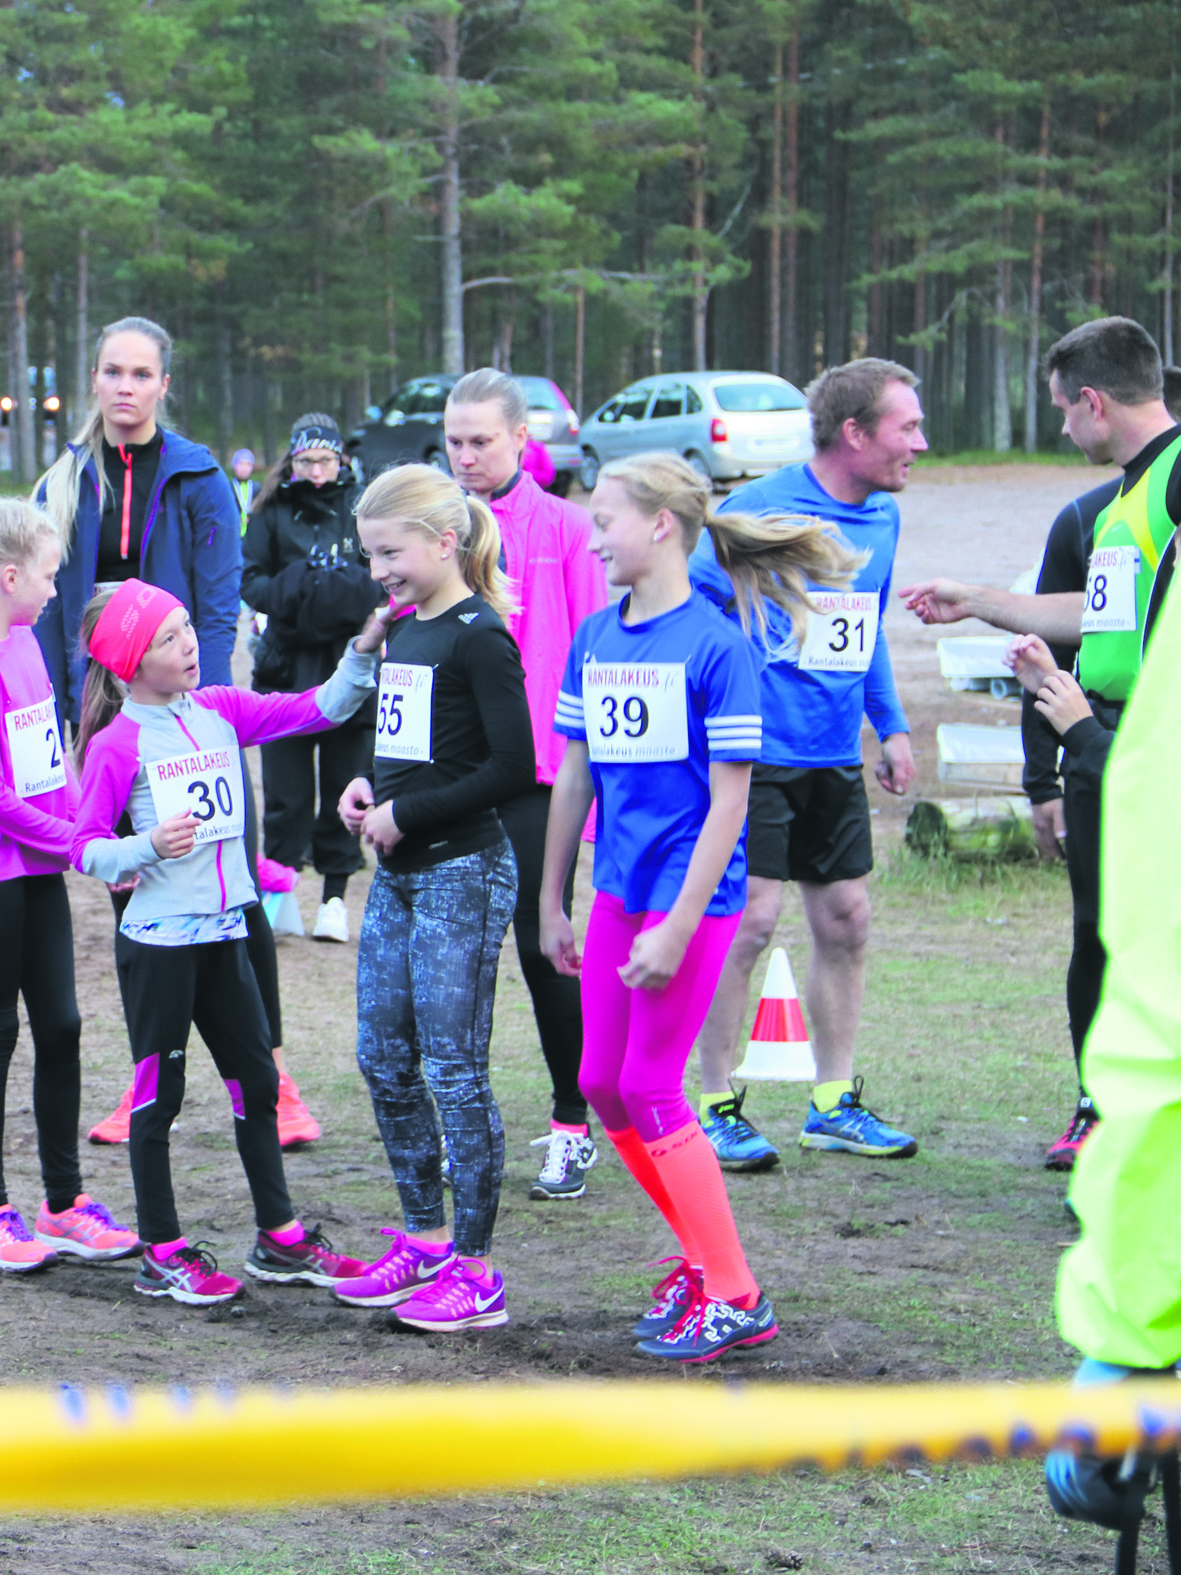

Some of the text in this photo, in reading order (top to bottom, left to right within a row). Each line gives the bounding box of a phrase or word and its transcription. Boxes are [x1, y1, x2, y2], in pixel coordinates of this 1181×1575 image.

[829, 617, 865, 653] 31
[378, 693, 403, 736] 55
[599, 695, 649, 738] 39
[187, 776, 233, 821] 30
